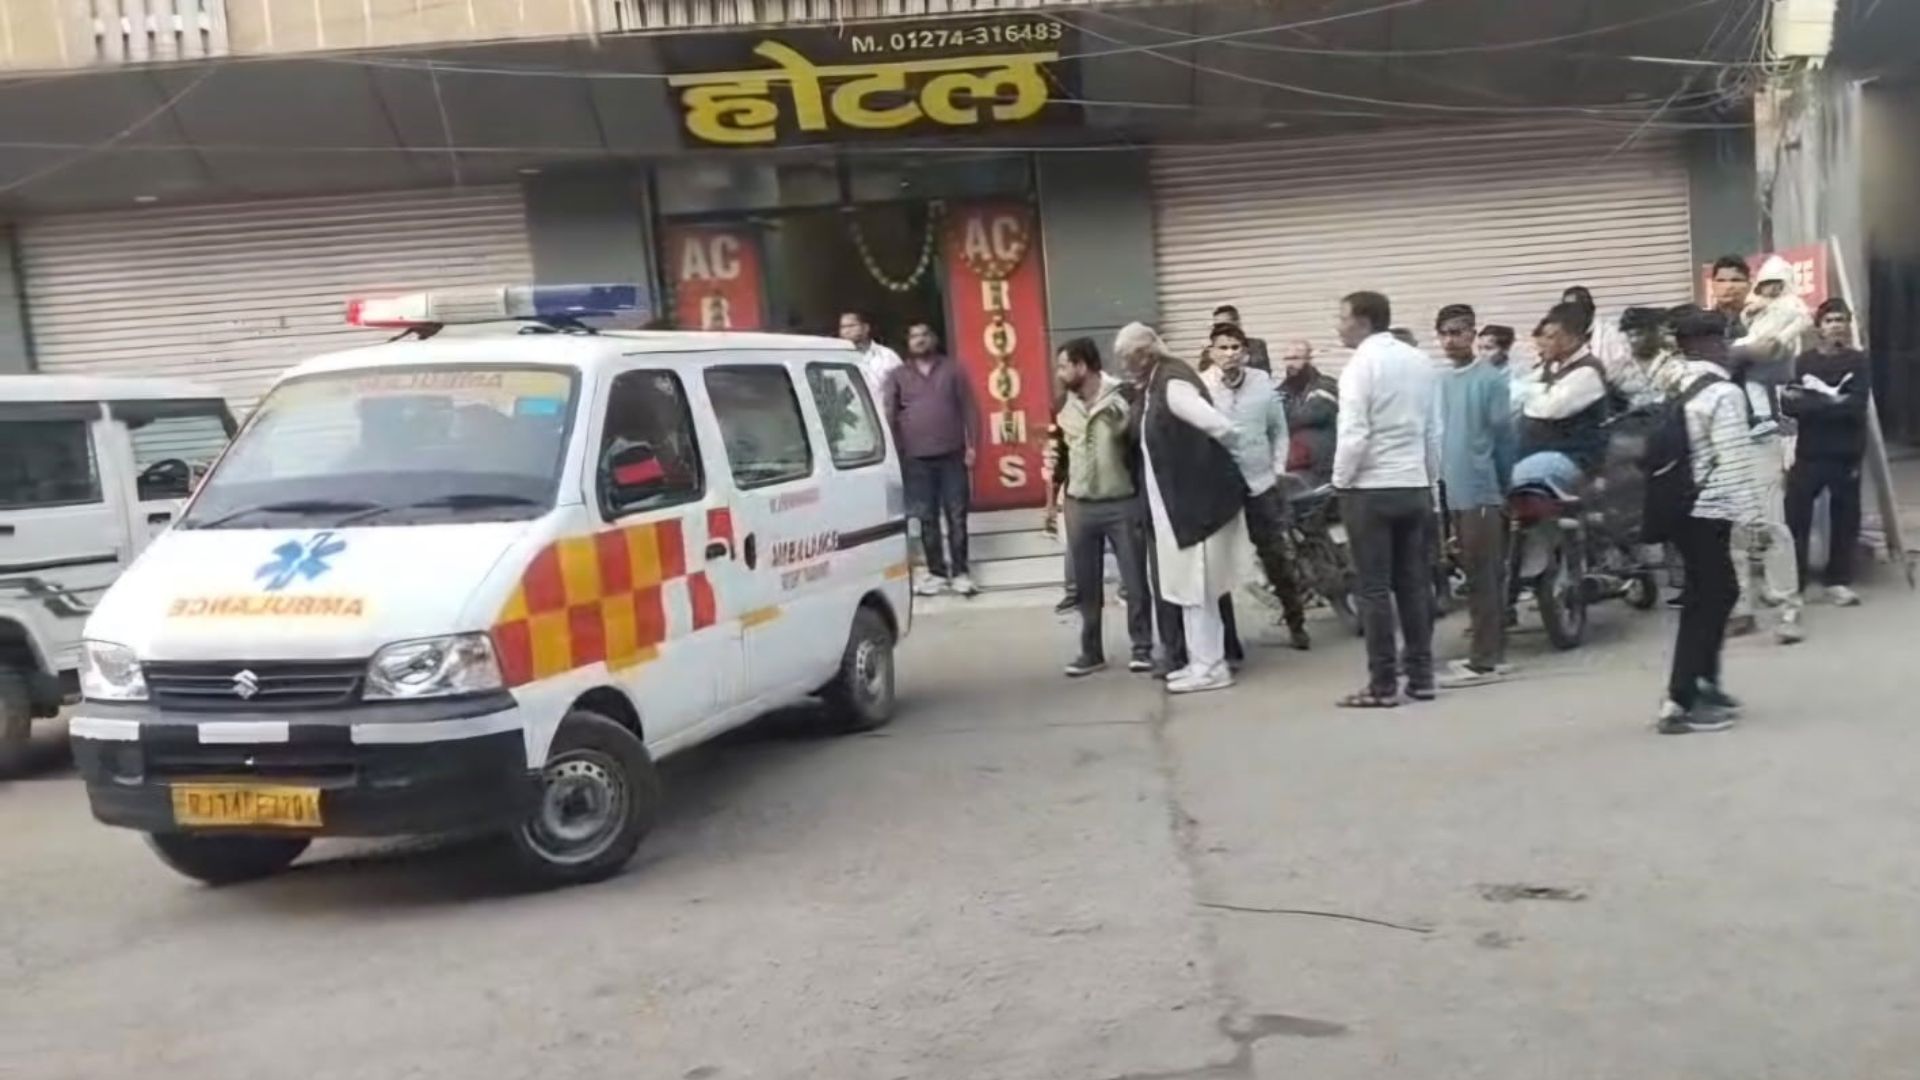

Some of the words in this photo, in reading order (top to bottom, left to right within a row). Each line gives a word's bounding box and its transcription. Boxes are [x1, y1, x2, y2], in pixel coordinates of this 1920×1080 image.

[851, 36, 883, 53] M.
[890, 22, 1063, 50] 01274-316483
[669, 40, 1059, 143] होटल
[681, 234, 741, 282] AC
[963, 216, 1023, 260] AC
[981, 280, 1028, 488] ROOMS
